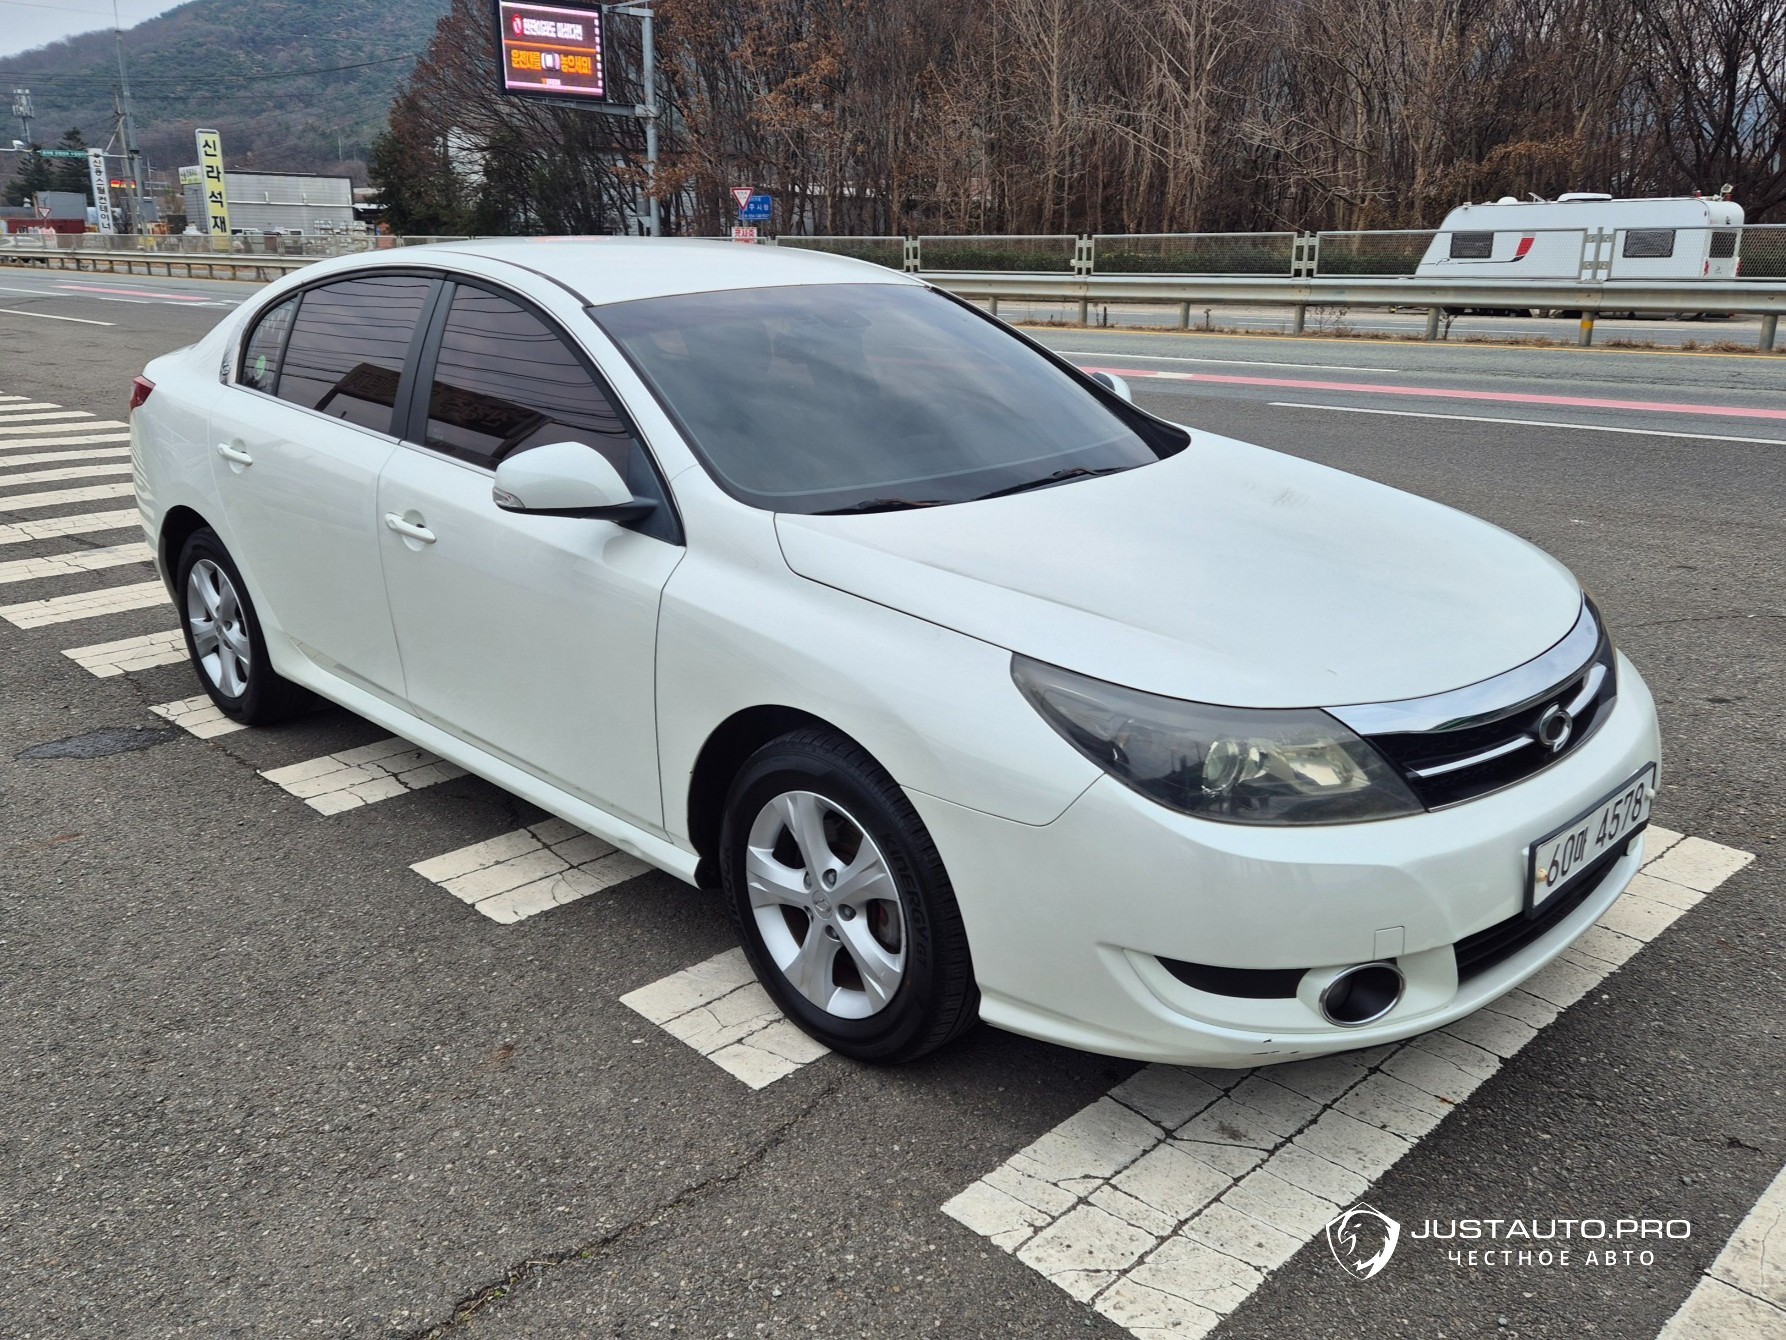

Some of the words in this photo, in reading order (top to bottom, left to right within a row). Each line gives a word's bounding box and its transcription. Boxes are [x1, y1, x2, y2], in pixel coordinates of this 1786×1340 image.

[511, 49, 542, 70] 운전대를
[203, 139, 227, 233] 신라석재
[1546, 825, 1590, 887] 60마
[1595, 782, 1645, 847] 4578
